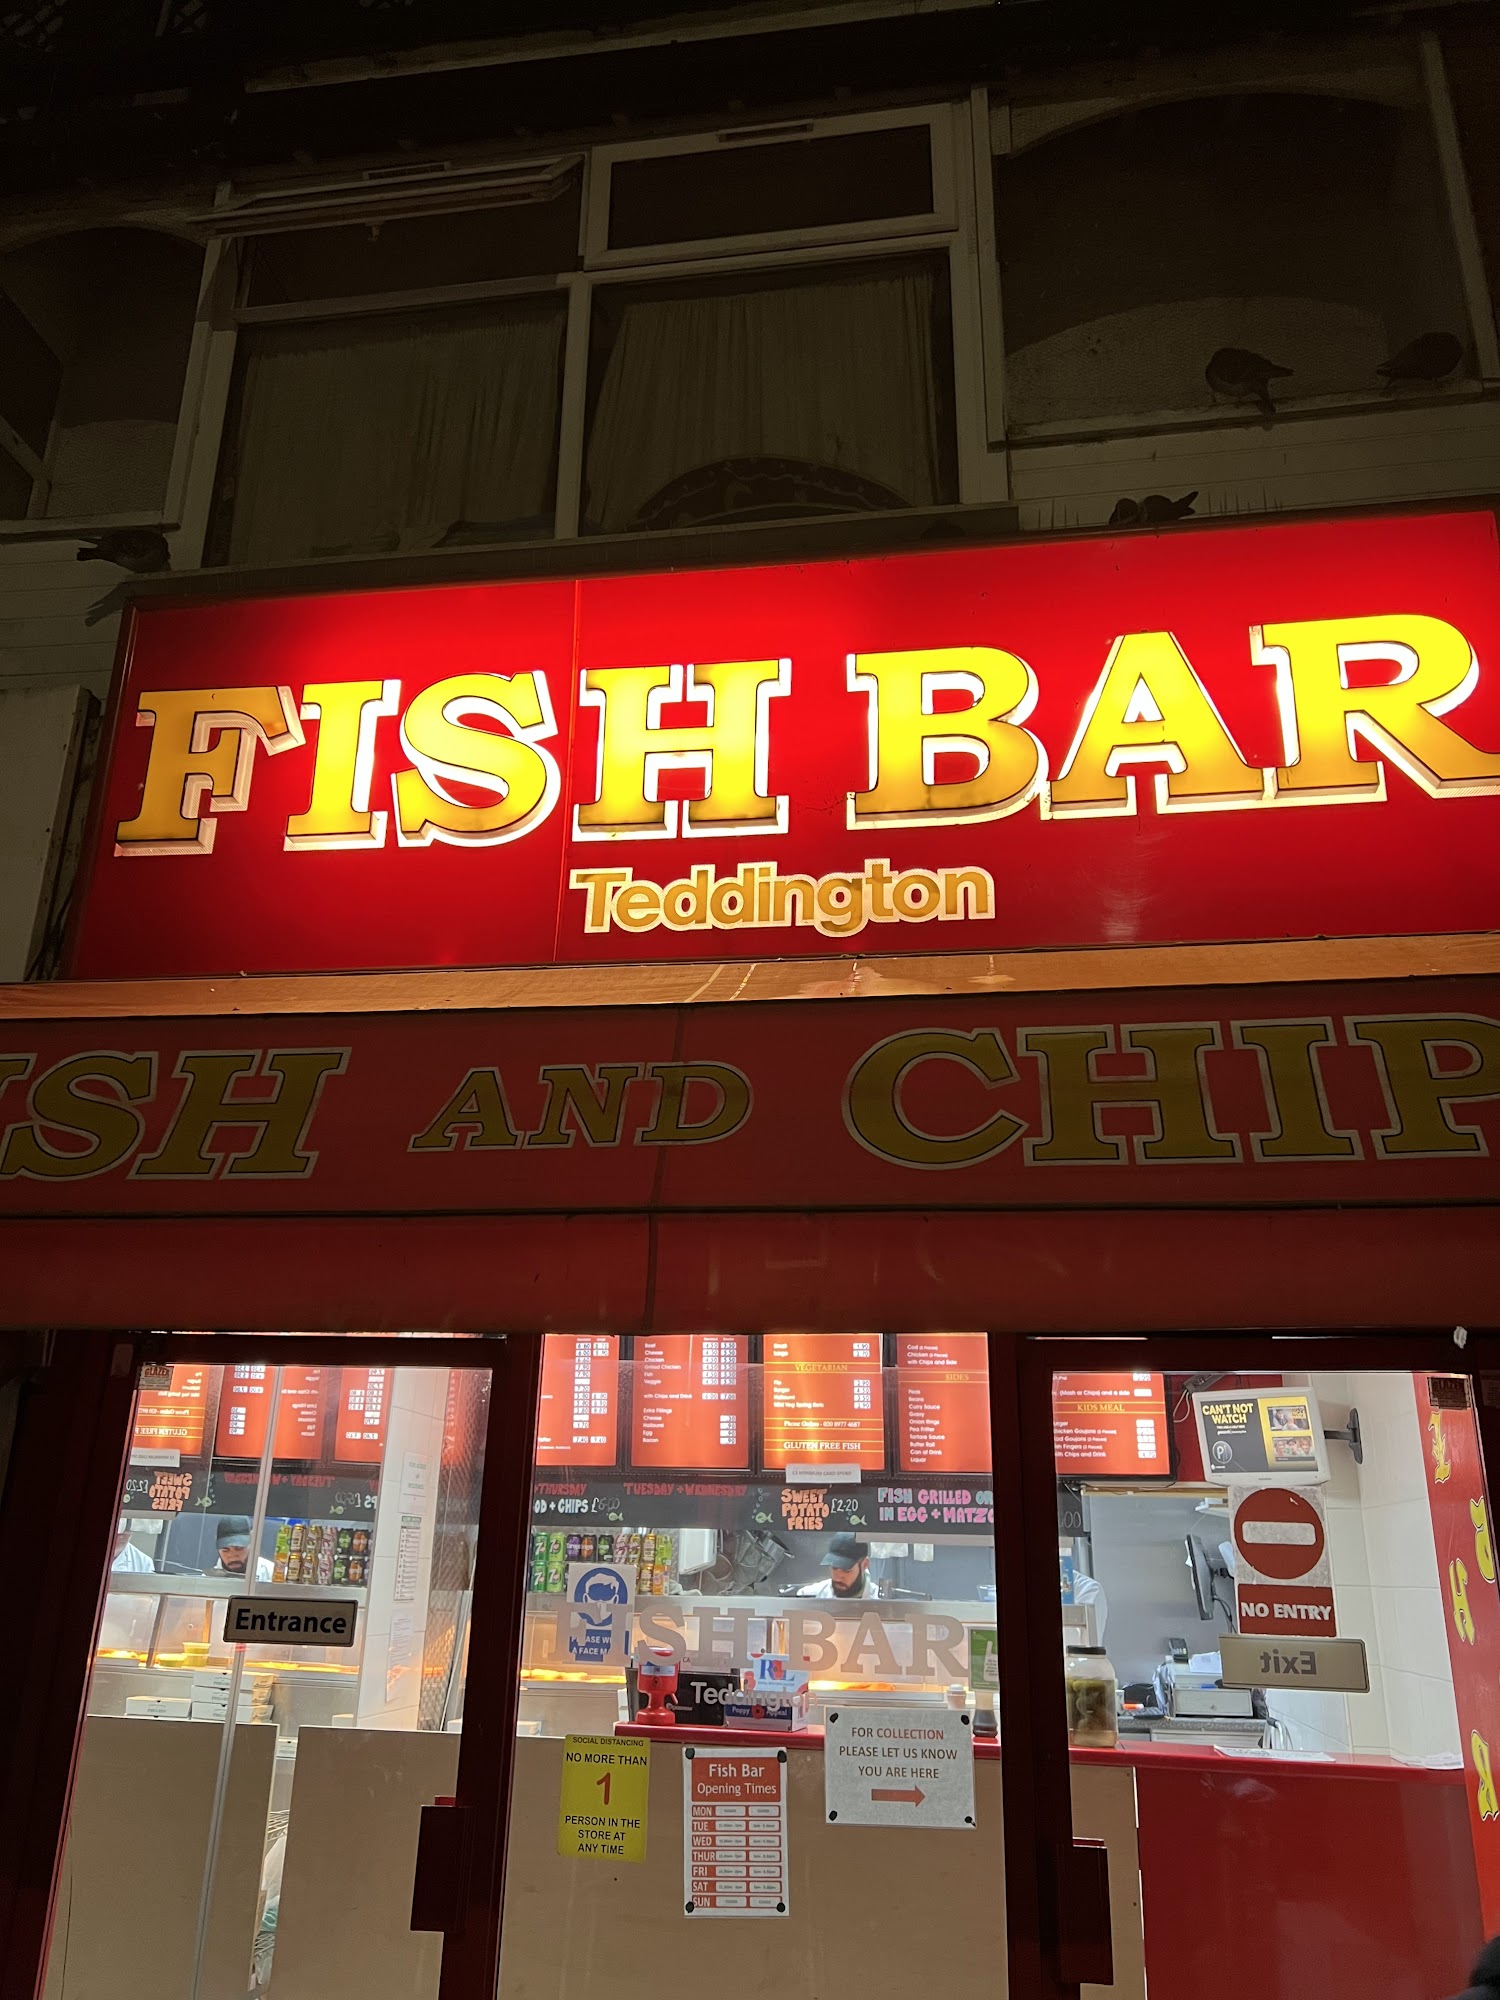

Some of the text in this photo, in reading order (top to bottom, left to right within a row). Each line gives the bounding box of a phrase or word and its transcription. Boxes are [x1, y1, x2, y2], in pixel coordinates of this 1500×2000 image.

[115, 614, 1500, 855] FISH BAR
[570, 858, 996, 938] Teddington
[0, 1046, 352, 1181] SH
[408, 1061, 753, 1152] AND
[1202, 1403, 1253, 1415] CAN'T NOT
[1212, 1414, 1247, 1424] WATCH
[623, 1482, 674, 1496] TUESDAY
[878, 1487, 913, 1504] FISH
[918, 1488, 971, 1504] GRILLED
[781, 1488, 828, 1504] SWEET
[534, 1500, 547, 1514] OD
[558, 1499, 589, 1514] CHIPS
[781, 1503, 830, 1518] POTATO
[879, 1507, 894, 1521] IN
[898, 1507, 928, 1523] EGG
[931, 1509, 941, 1519] +
[787, 1517, 823, 1530] FRIES
[1241, 1602, 1332, 1621] NO ENTRY
[235, 1608, 347, 1634] Entrance
[550, 1602, 968, 1680] FISH BAR
[691, 1681, 818, 1713] Teddington
[852, 1727, 944, 1740] FOR COLLECTION
[600, 1737, 644, 1747] DISTANCING
[566, 1752, 647, 1766] NO MORE THAN
[840, 1746, 957, 1759] PLEASE LET US KNOW
[709, 1764, 765, 1777] Fish Bar
[858, 1766, 939, 1778] YOU ARE HERE
[597, 1772, 611, 1805] 1
[697, 1782, 776, 1796] Opening Times
[693, 1807, 712, 1816] MON
[565, 1815, 640, 1828] PERSON IN THE
[692, 1821, 709, 1831] TUE
[578, 1830, 626, 1840] STORE AT
[693, 1836, 712, 1846] WED
[578, 1843, 624, 1854] ANY TIME
[693, 1851, 715, 1861] THUR
[693, 1866, 708, 1876] FRI
[693, 1882, 708, 1892] SAT
[693, 1897, 711, 1907] SUN
